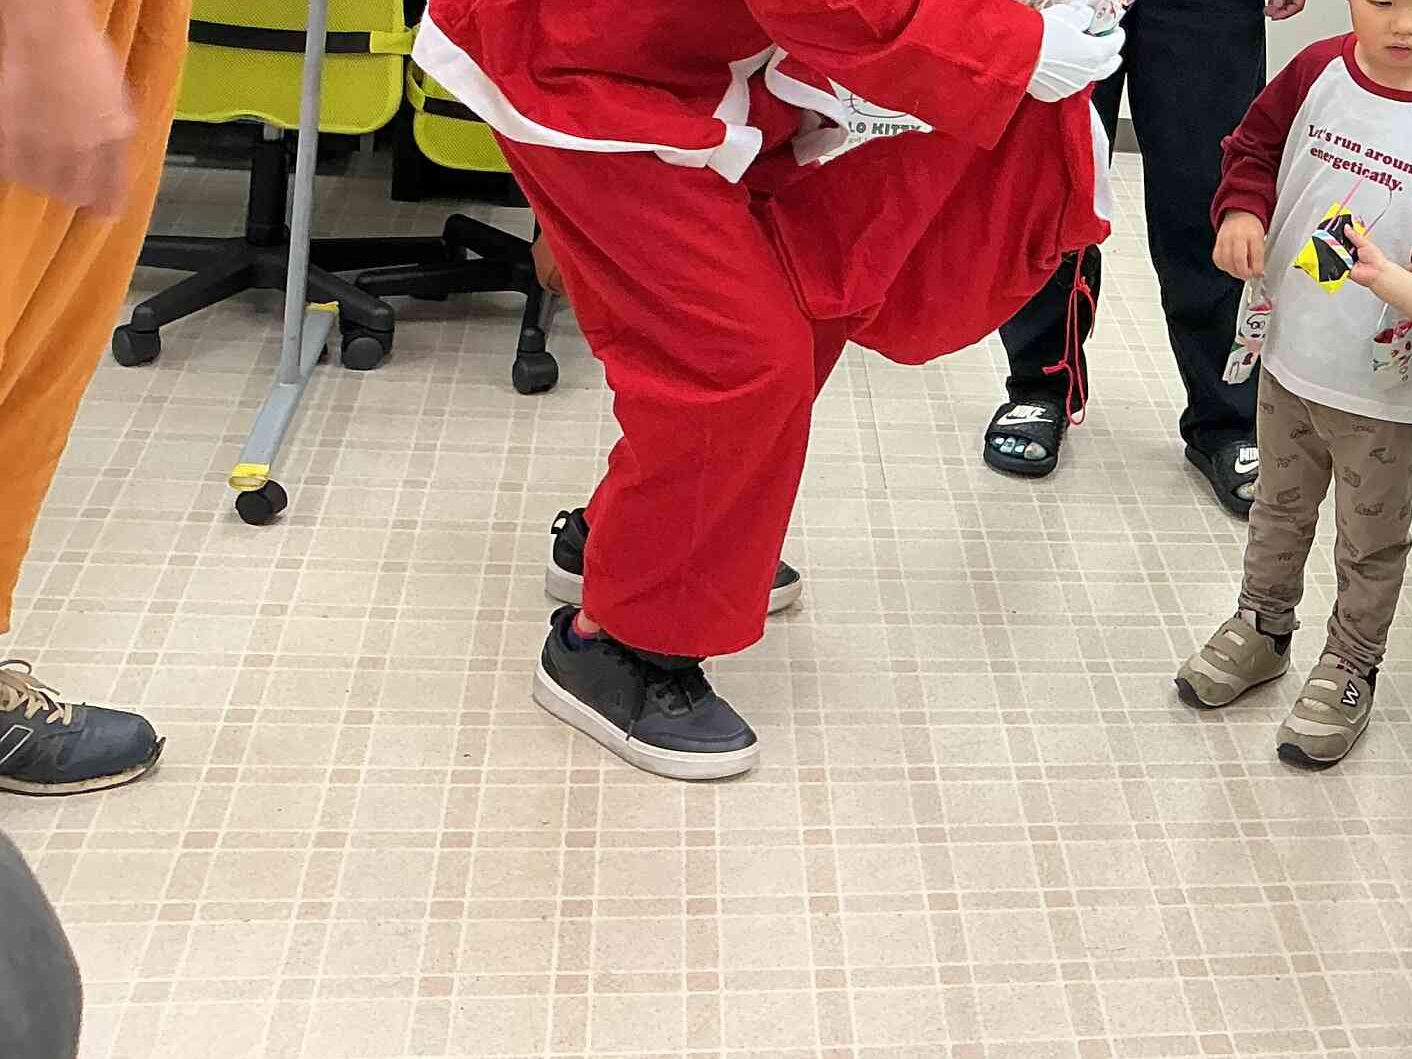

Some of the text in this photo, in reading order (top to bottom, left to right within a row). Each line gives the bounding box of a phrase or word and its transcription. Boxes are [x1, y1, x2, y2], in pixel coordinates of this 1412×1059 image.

[1334, 135, 1361, 153] run
[1311, 147, 1402, 191] energetically.
[1008, 405, 1047, 418] NIKE
